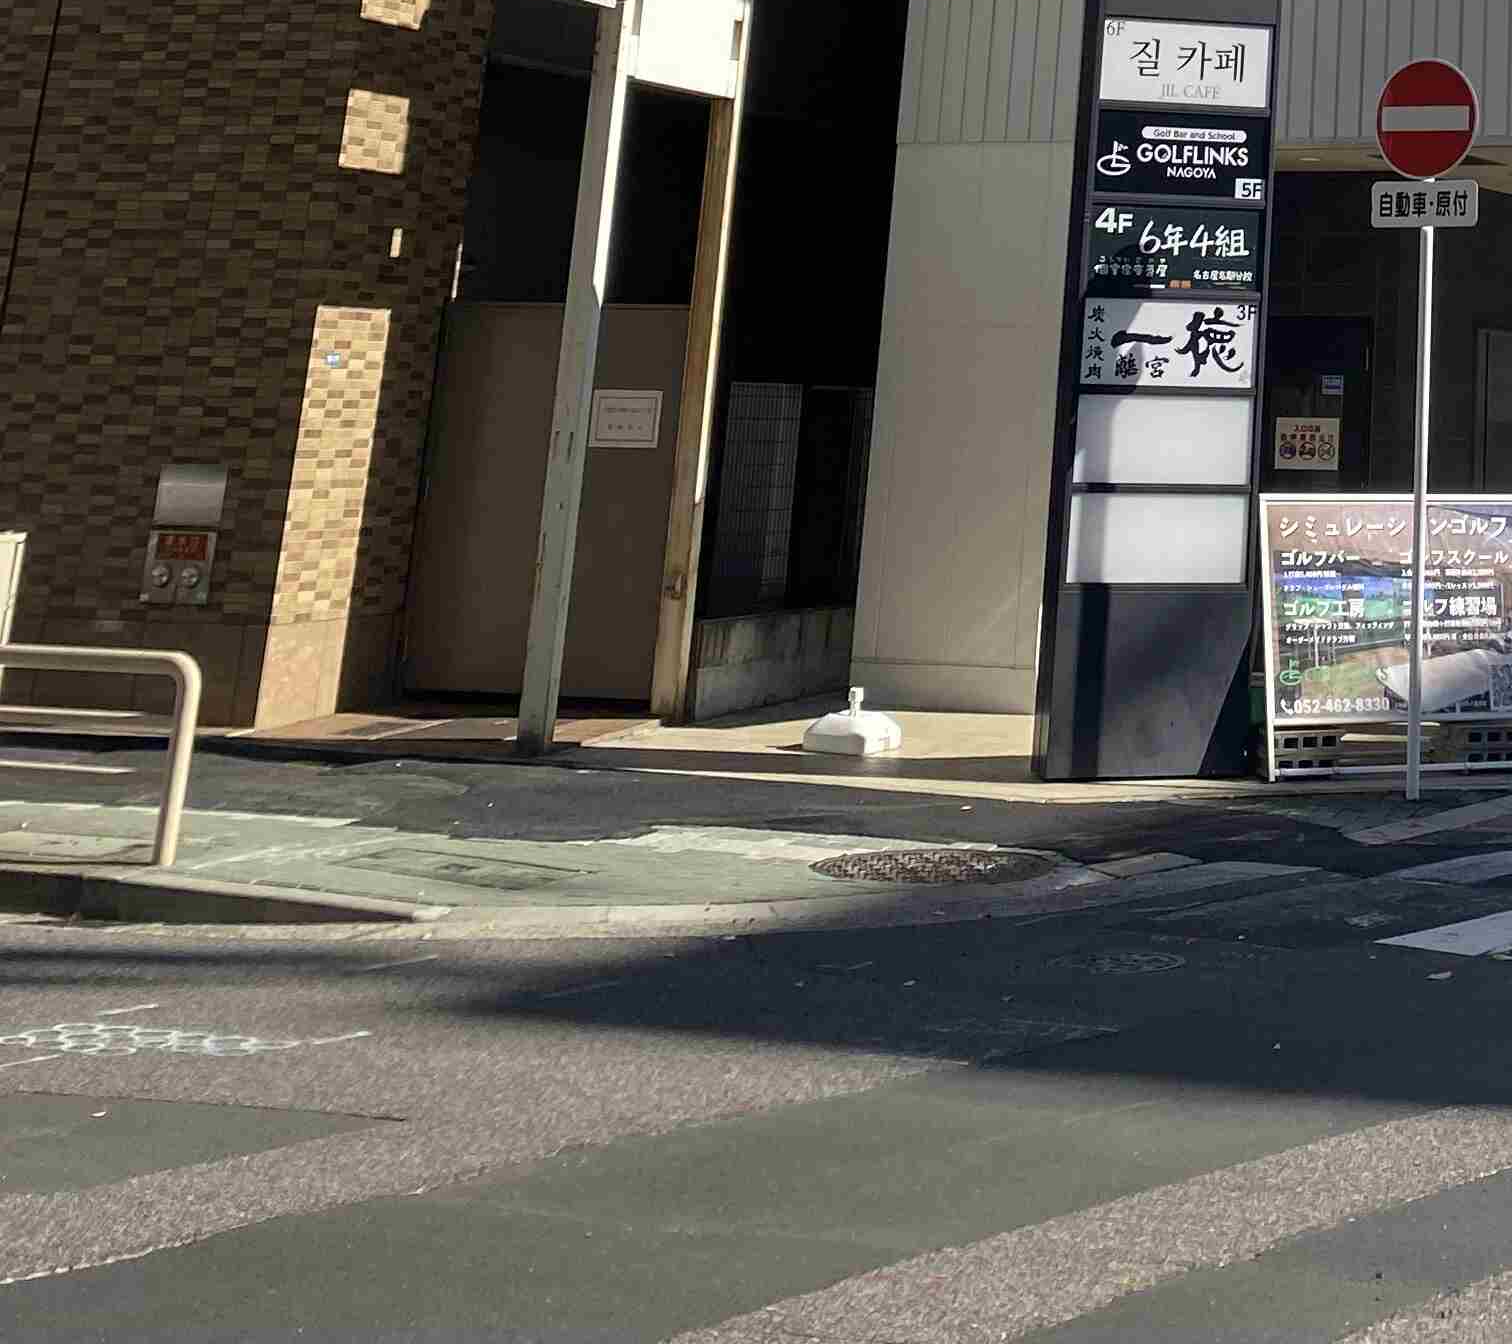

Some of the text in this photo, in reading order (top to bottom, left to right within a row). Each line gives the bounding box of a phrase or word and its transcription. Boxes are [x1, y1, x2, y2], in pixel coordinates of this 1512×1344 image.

[1106, 21, 1125, 37] 6F
[1129, 38, 1247, 83] 질 카페
[1153, 129, 1236, 141] Golf Bar and School
[1137, 143, 1249, 167] GOLFLINKS
[1167, 166, 1216, 179] NAGOYA
[1242, 182, 1263, 198] 5F
[1379, 190, 1468, 218] 自動車・原付
[1095, 207, 1133, 234] 4F
[1139, 220, 1250, 257] 6年4組
[1236, 304, 1257, 321] 3F
[1280, 514, 1507, 544] シミュレーシンゴルフ
[1280, 549, 1361, 566] ゴルフバー
[1400, 549, 1509, 565] ゴフスクール
[1283, 598, 1365, 618] ゴルフ工房
